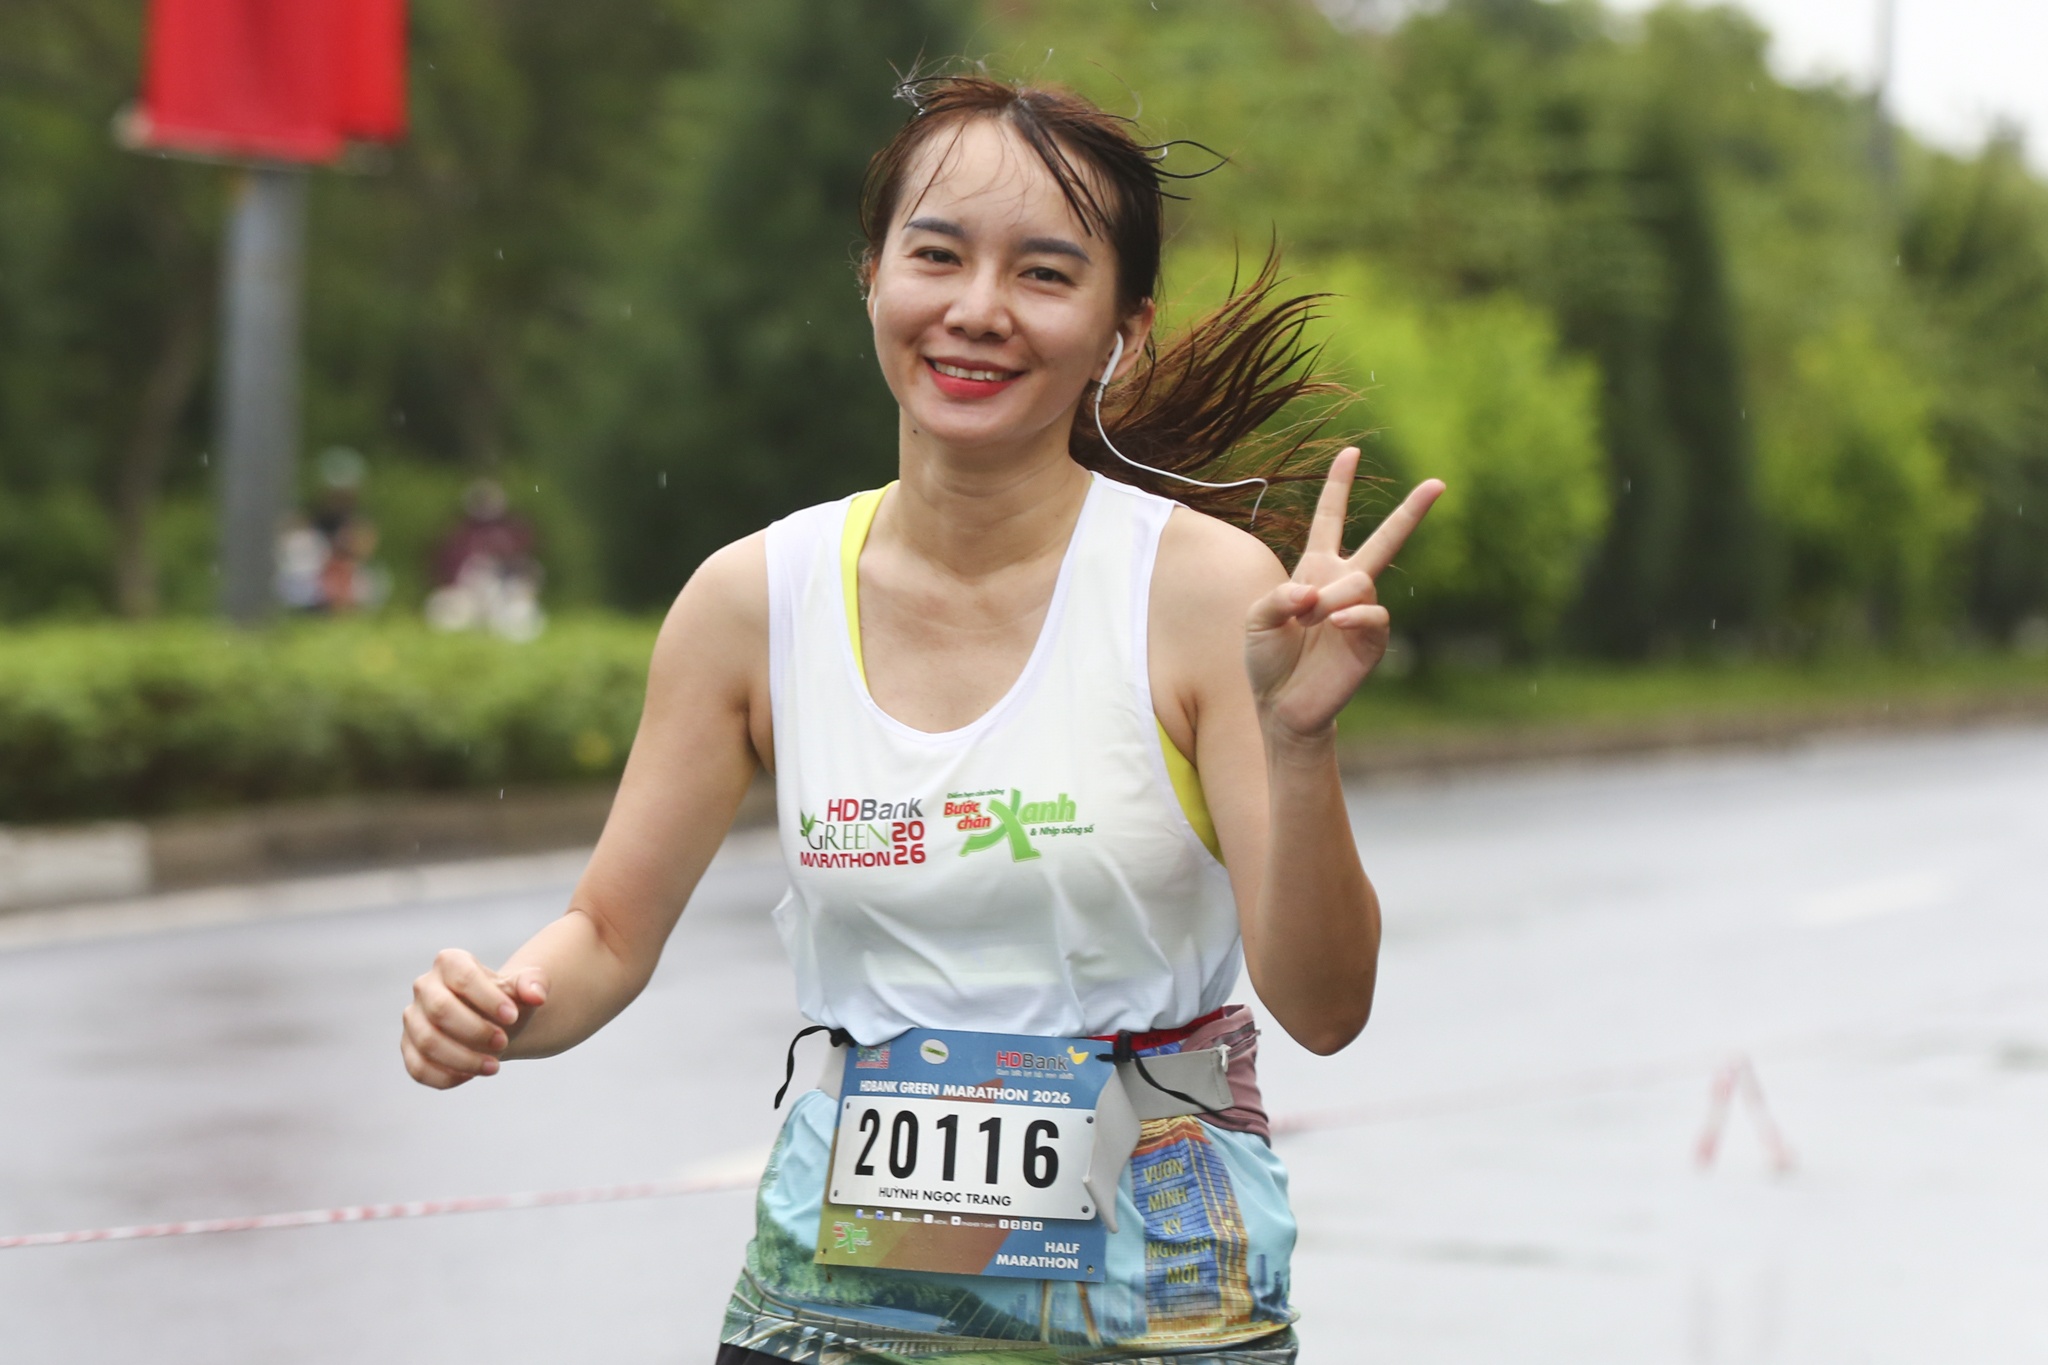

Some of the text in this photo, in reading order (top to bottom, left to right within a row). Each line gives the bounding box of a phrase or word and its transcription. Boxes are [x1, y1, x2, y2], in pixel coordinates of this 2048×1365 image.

[943, 800, 981, 816] Bước
[957, 814, 991, 830] chân
[1030, 827, 1037, 836] &
[803, 819, 925, 850] GREEN 20
[800, 843, 926, 868] MARATHON 26
[996, 1050, 1068, 1071] HDBank
[860, 1080, 1072, 1104] HDBANK GREEN MARATHON 2026
[854, 1108, 1060, 1189] 20116
[878, 1186, 1012, 1207] HUỲNH NGỌC TRANG
[1045, 1241, 1081, 1254] HALF
[995, 1253, 1079, 1270] MARATHON
